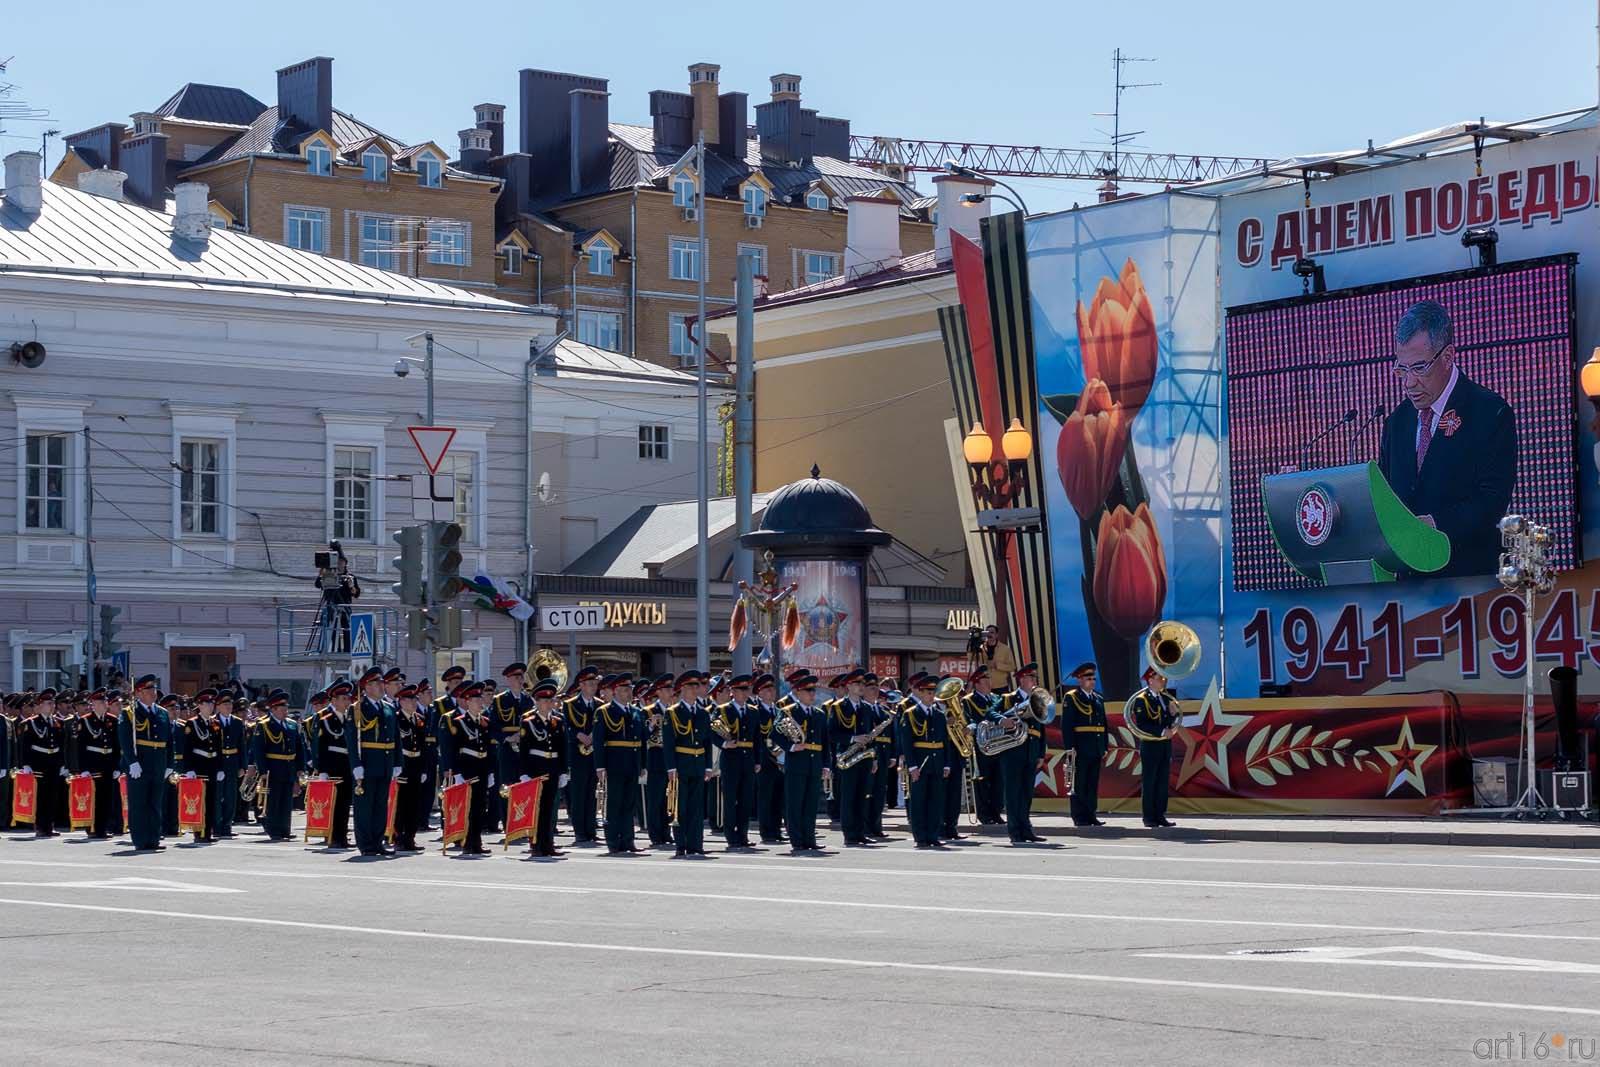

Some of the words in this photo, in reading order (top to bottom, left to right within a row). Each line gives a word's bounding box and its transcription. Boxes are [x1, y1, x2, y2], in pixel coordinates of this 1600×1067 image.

[1237, 217, 1263, 267] С
[1270, 193, 1394, 270] ДНЕМ
[549, 610, 597, 627] СТОП
[579, 601, 666, 628] ОДУКТЫ
[946, 609, 983, 631] АША
